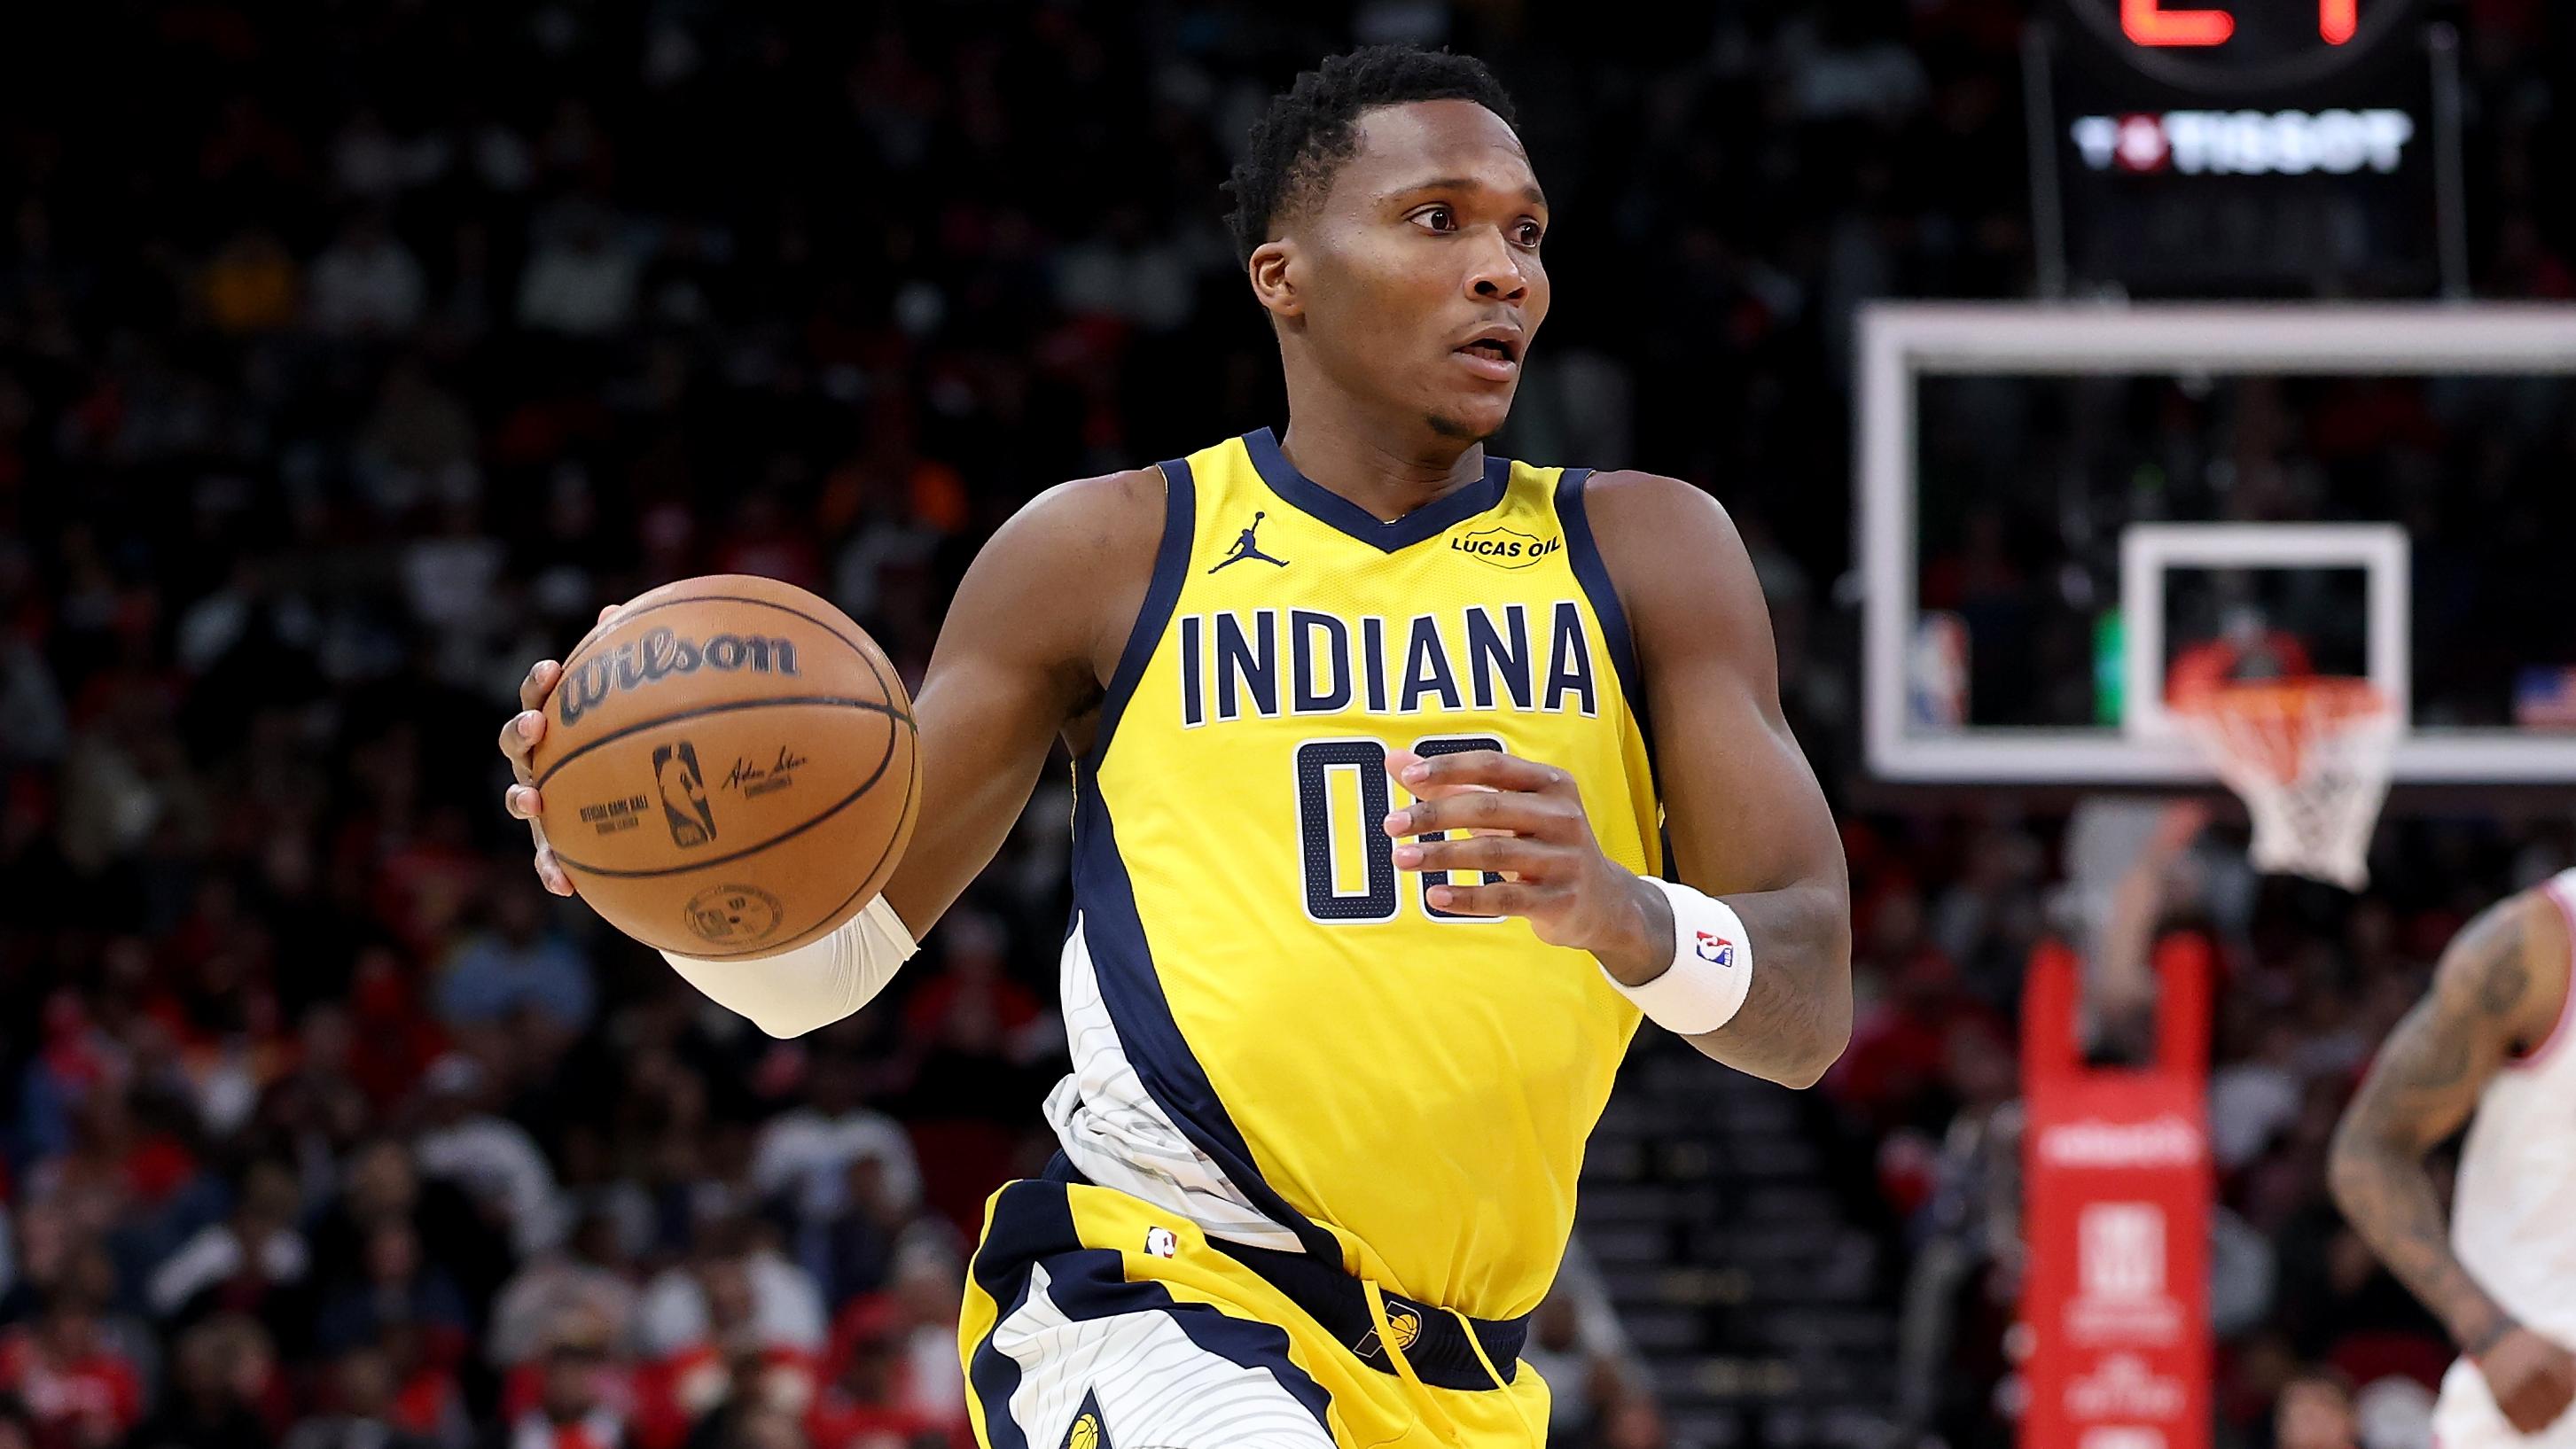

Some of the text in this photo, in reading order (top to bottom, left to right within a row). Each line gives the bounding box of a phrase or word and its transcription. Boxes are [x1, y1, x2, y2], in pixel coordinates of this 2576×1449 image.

[1451, 534, 1561, 557] LUCAS OIL
[558, 627, 801, 727] Wilson
[1179, 600, 1598, 730] INDIANA
[1292, 732, 1510, 925] 0
